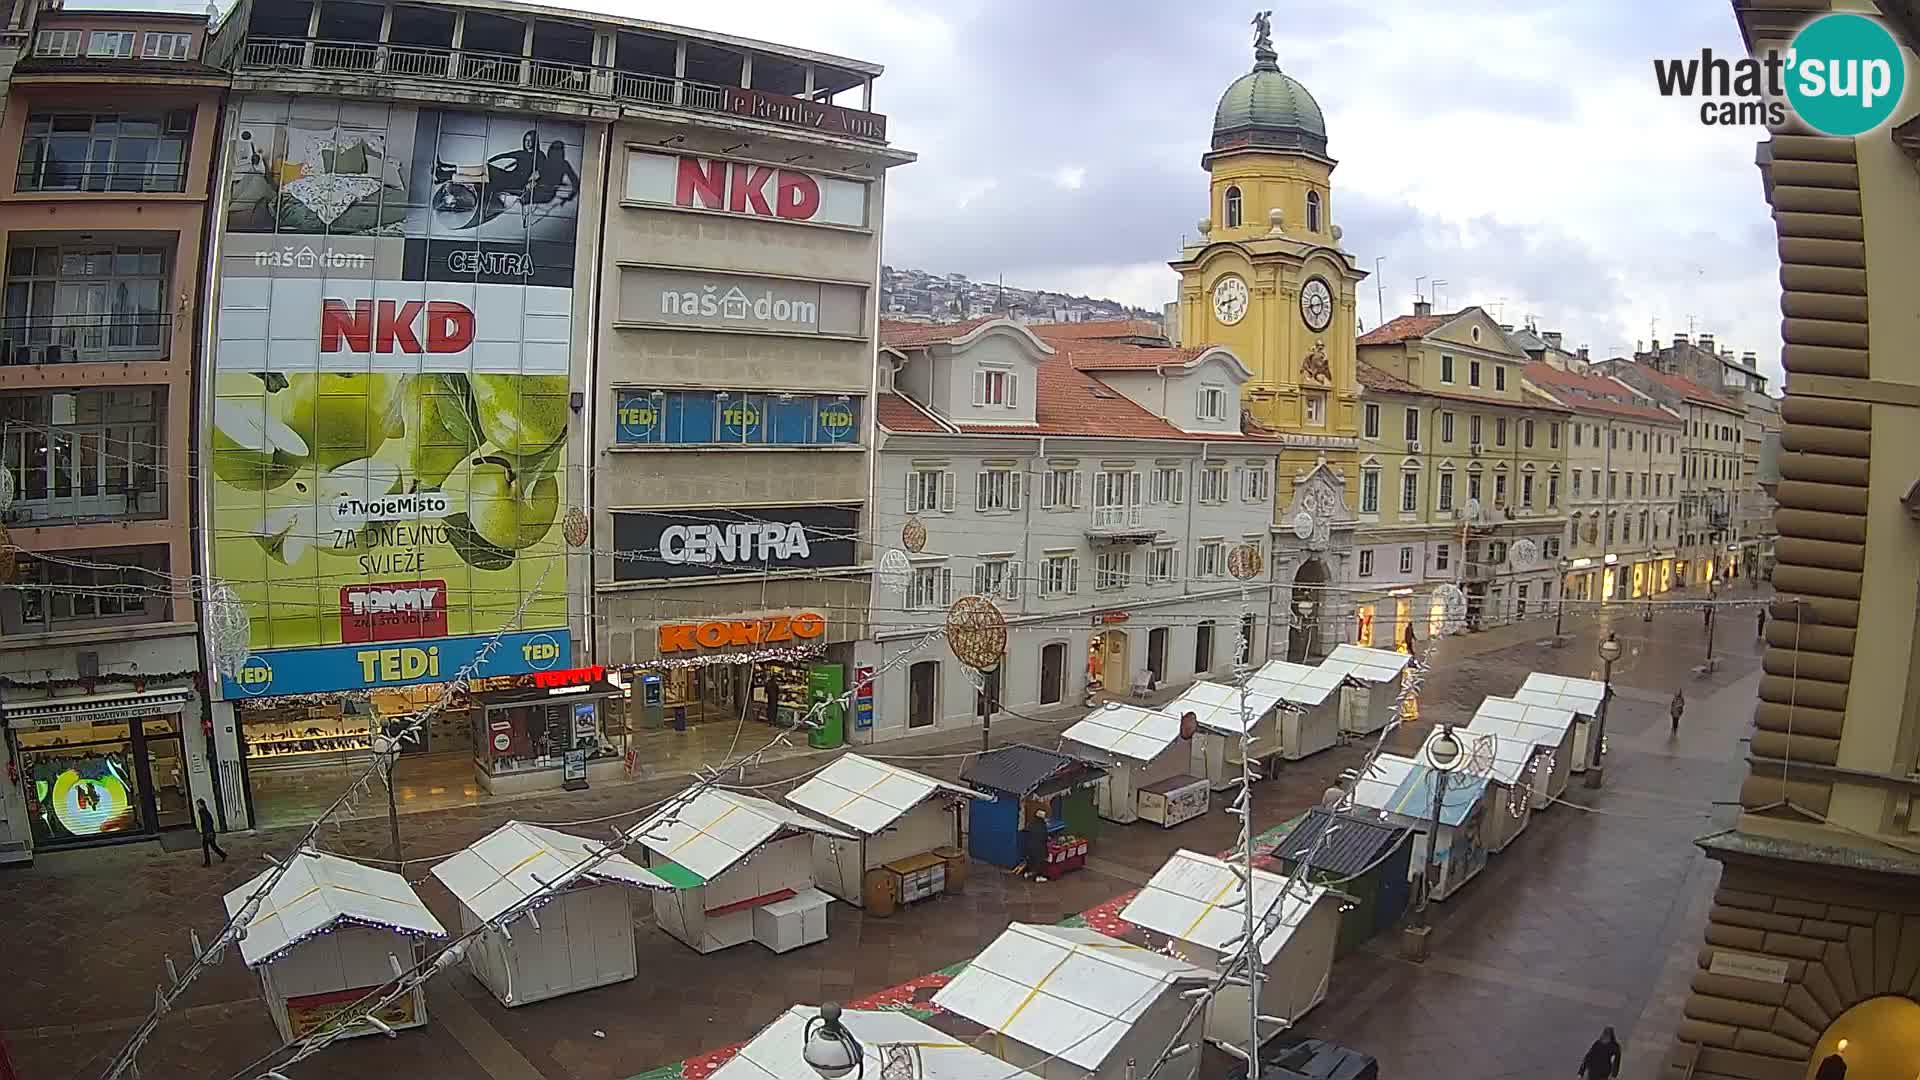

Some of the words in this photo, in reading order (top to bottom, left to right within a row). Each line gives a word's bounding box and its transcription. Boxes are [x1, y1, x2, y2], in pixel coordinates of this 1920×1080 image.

[675, 158, 820, 220] NKD
[255, 247, 294, 268] naš
[319, 248, 365, 268] dom
[448, 250, 534, 276] CENTRA
[661, 284, 718, 317] naš
[753, 290, 816, 324] dom
[320, 297, 477, 355] NKD
[618, 407, 658, 426] TEDi
[723, 408, 760, 426] TEDi
[819, 410, 854, 427] TEDi
[338, 497, 446, 516] #TvojeMisto
[333, 528, 358, 549] ZA
[366, 524, 450, 548] DNEVNO
[658, 521, 810, 565] CENTRA
[359, 547, 425, 575] SVJEŽE
[348, 587, 439, 614] TOMMY
[658, 613, 825, 653] KORZO
[357, 646, 440, 683] TEDi
[522, 643, 560, 661] TEDi
[236, 667, 273, 685] TEDi
